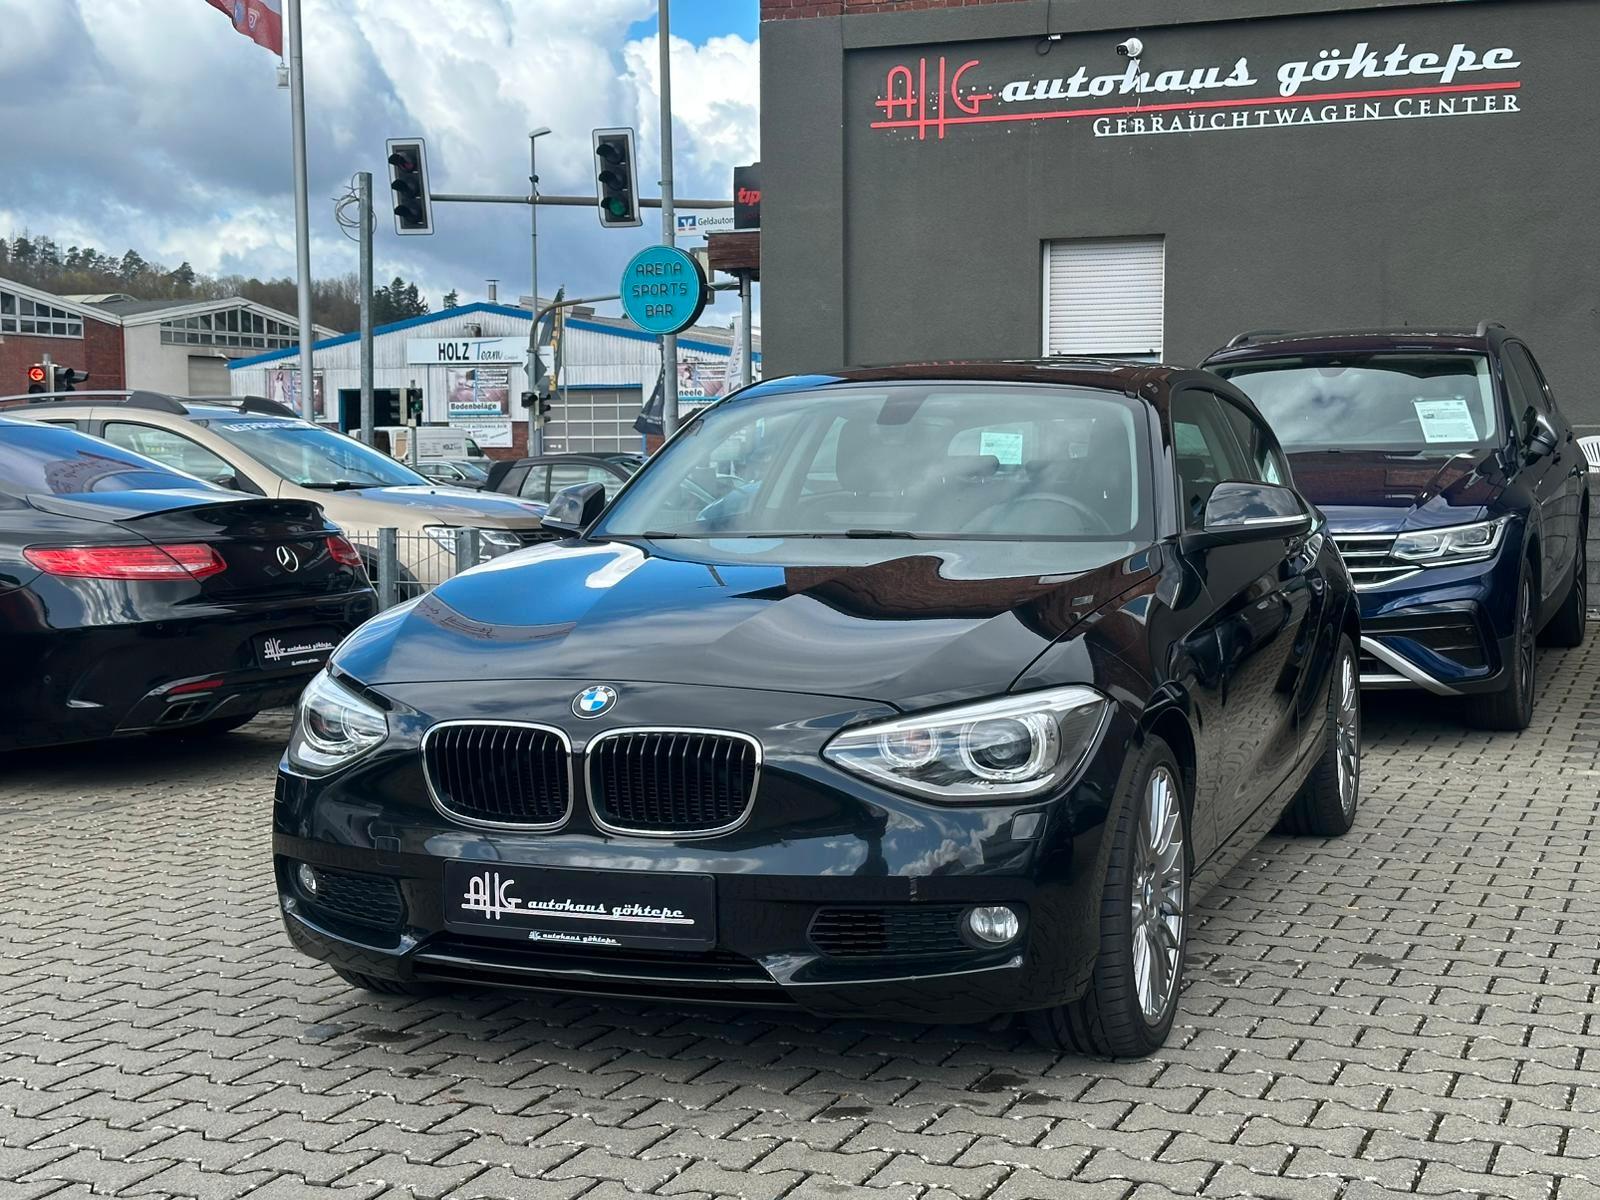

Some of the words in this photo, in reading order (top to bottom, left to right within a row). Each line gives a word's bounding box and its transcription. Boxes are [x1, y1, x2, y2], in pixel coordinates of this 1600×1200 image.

[873, 56, 993, 140] AHG
[1001, 57, 1257, 103] autohaus
[1278, 43, 1521, 97] göktepe
[1092, 101, 1380, 136] GEBRAUCHTWAGEN
[1393, 93, 1520, 118] CENTER
[635, 262, 682, 276] ARENA
[631, 283, 688, 297] SPORTS
[645, 304, 674, 317] BAR
[438, 342, 470, 361] HOLZ
[471, 339, 504, 361] Team
[528, 898, 606, 914] autohaus
[612, 903, 685, 919] göktepe
[542, 933, 580, 942] autohaus
[582, 935, 617, 944] göktepe
